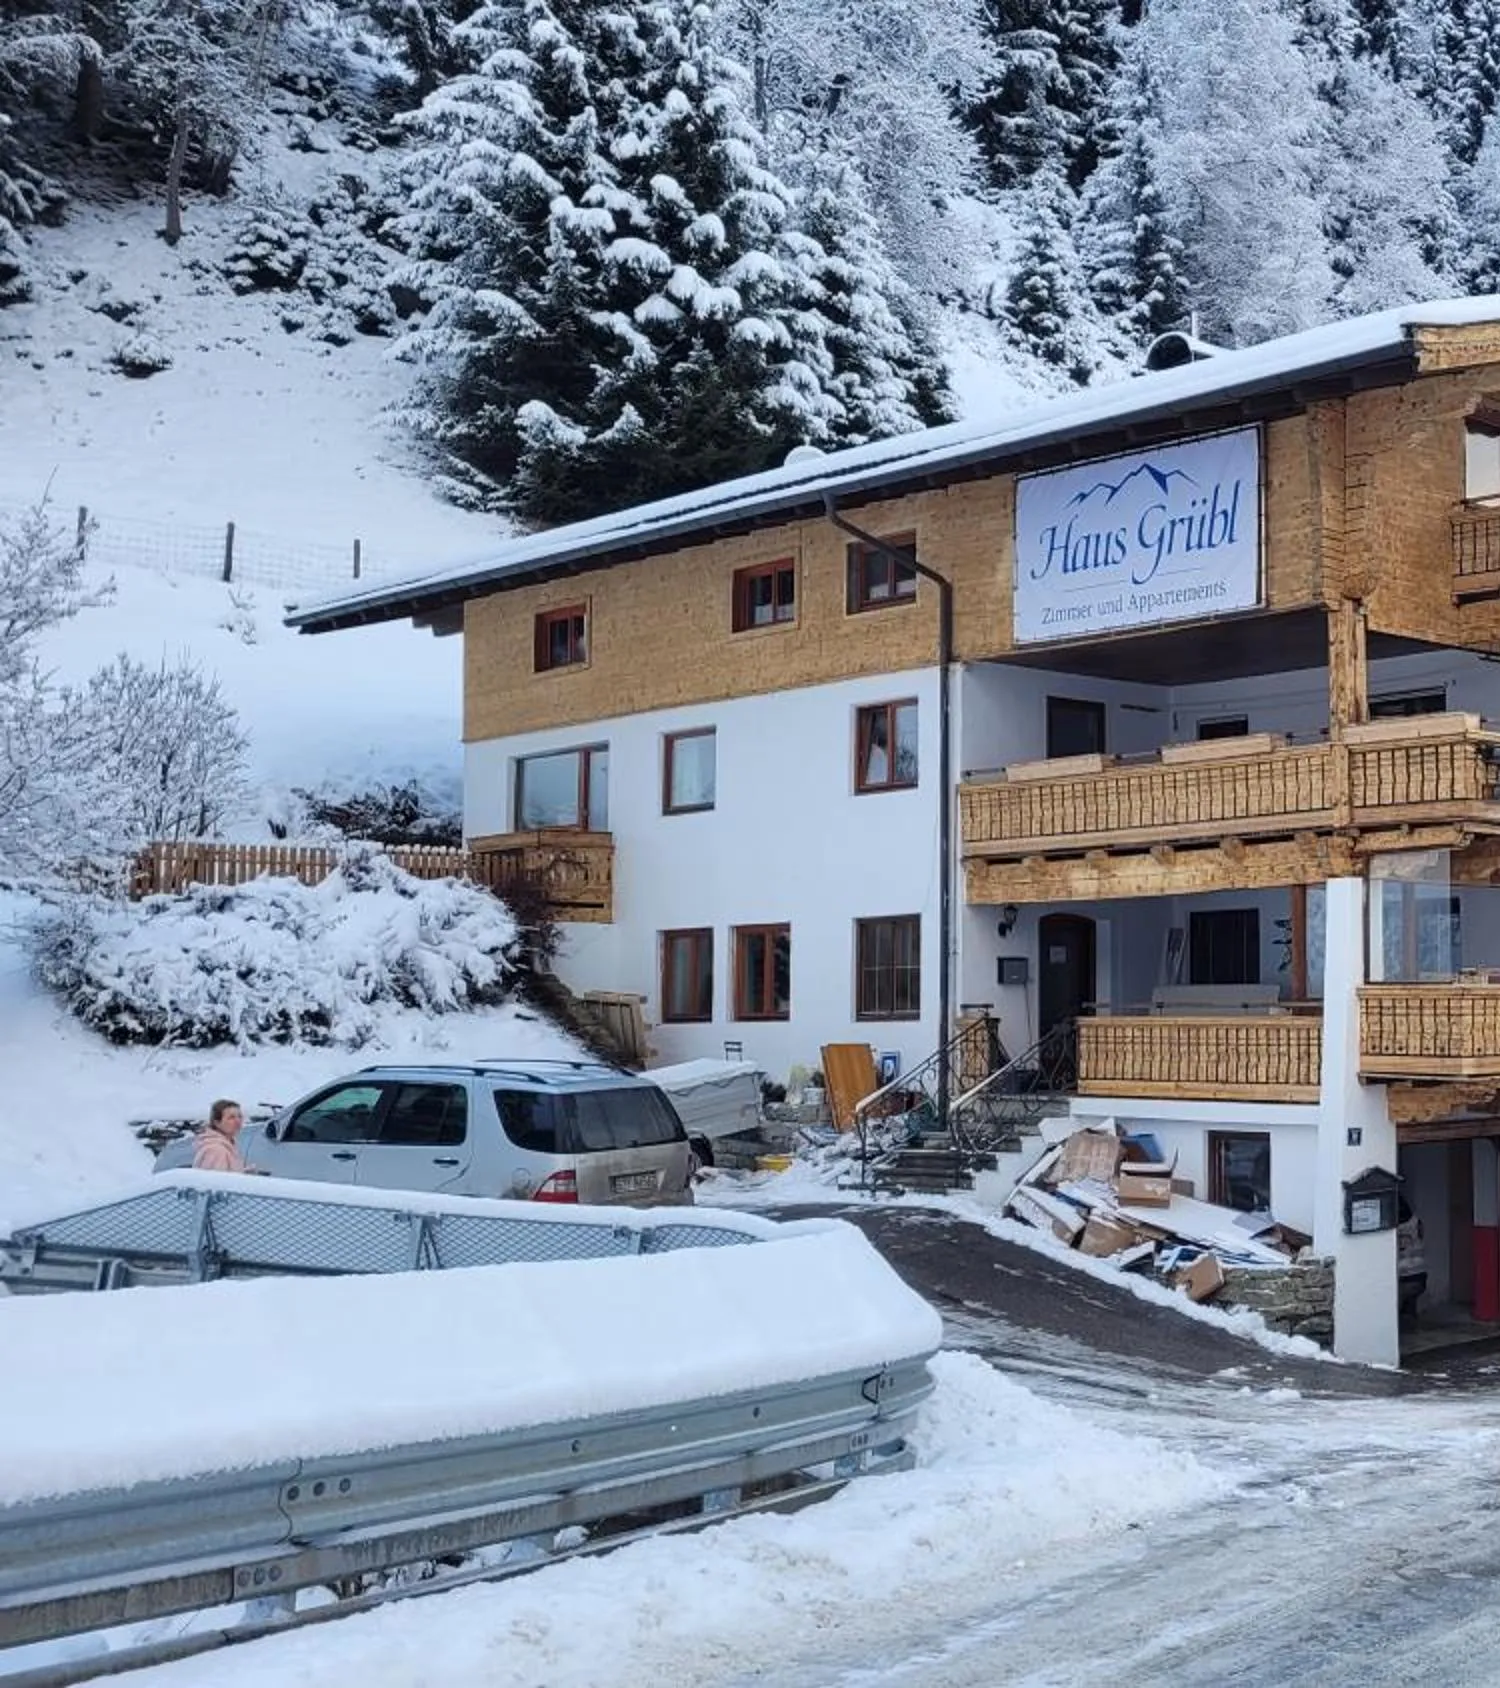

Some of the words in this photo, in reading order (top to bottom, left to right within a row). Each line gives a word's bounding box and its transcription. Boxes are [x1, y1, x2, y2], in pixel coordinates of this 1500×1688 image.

[1030, 513, 1127, 580] Haus
[1131, 479, 1241, 585] Grübl
[1041, 604, 1092, 625] Zimmer
[1099, 595, 1123, 616] und
[1127, 580, 1227, 612] Appartements
